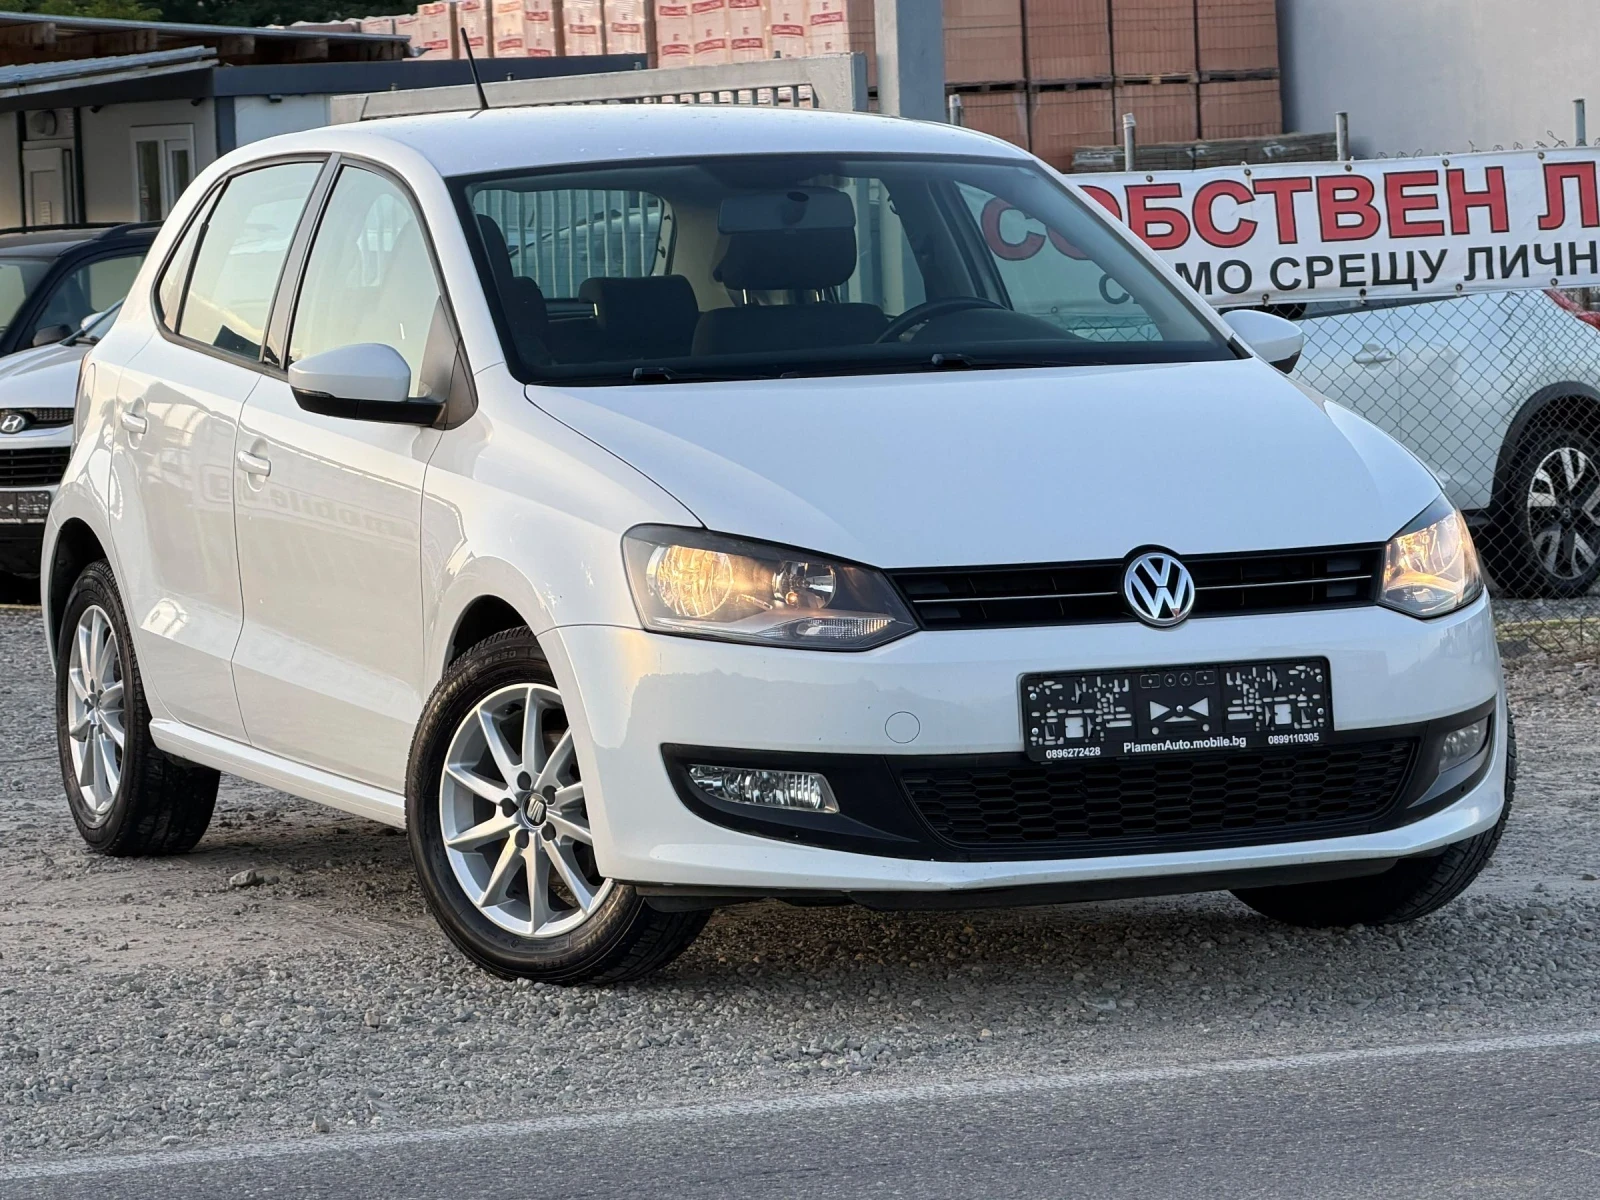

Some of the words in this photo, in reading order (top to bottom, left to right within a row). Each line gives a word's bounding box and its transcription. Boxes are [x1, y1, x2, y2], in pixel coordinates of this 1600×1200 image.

[1098, 258, 1252, 304] СМО
[1269, 248, 1448, 291] СРЕЩУ
[1463, 240, 1599, 281] ЛИЧН
[1123, 735, 1247, 754] PlamenAuto.mobile.bg
[1267, 732, 1320, 745] 0899110305
[1045, 747, 1101, 759] 0896272428
